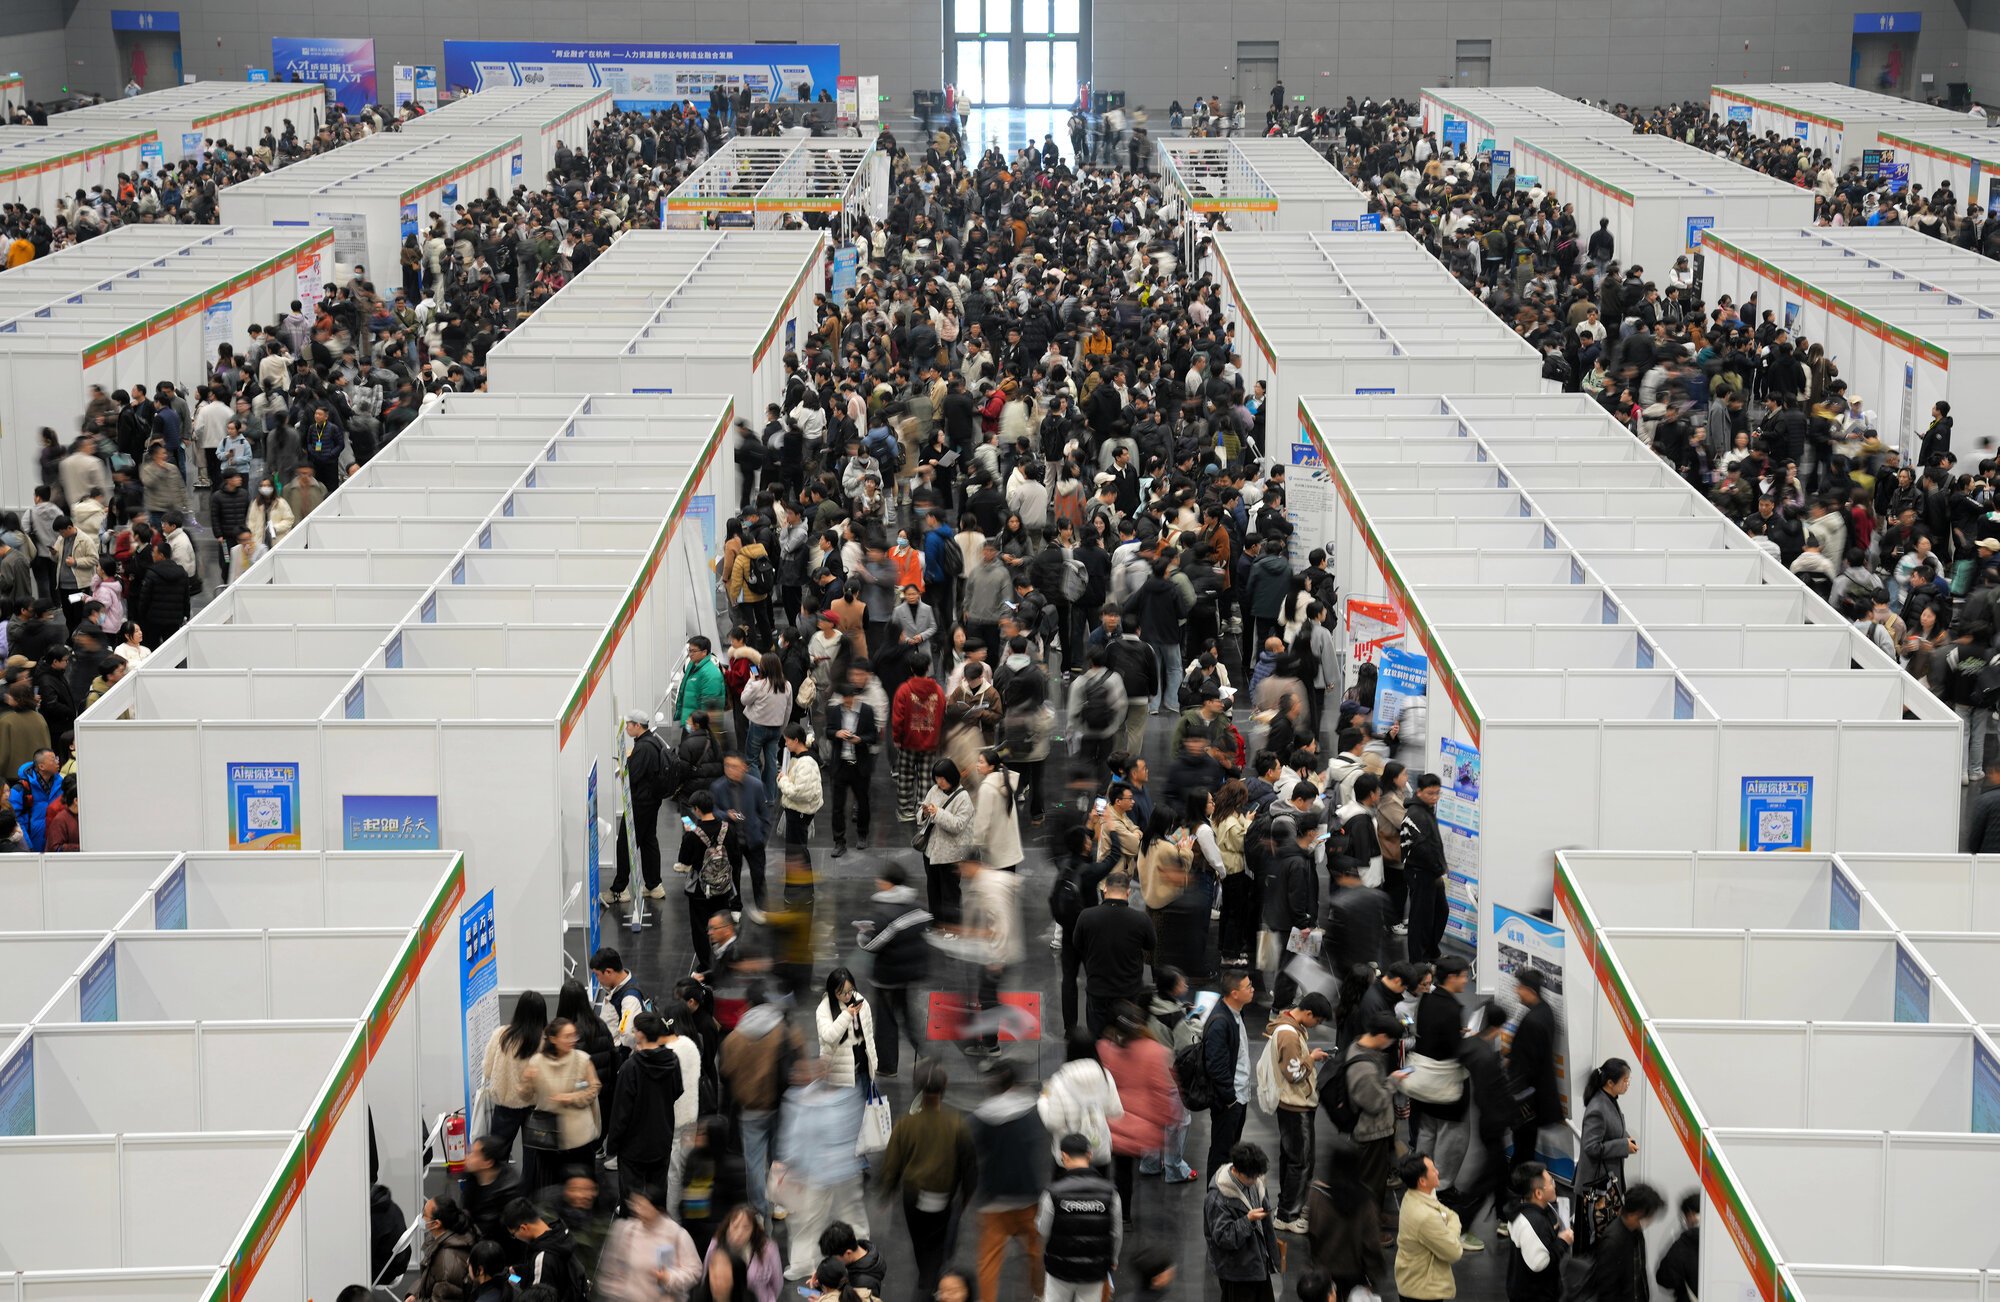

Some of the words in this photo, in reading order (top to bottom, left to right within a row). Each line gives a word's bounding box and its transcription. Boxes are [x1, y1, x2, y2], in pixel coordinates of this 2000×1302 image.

[287, 60, 354, 74] 人才成就浙江
[362, 815, 432, 834] 起跑春天
